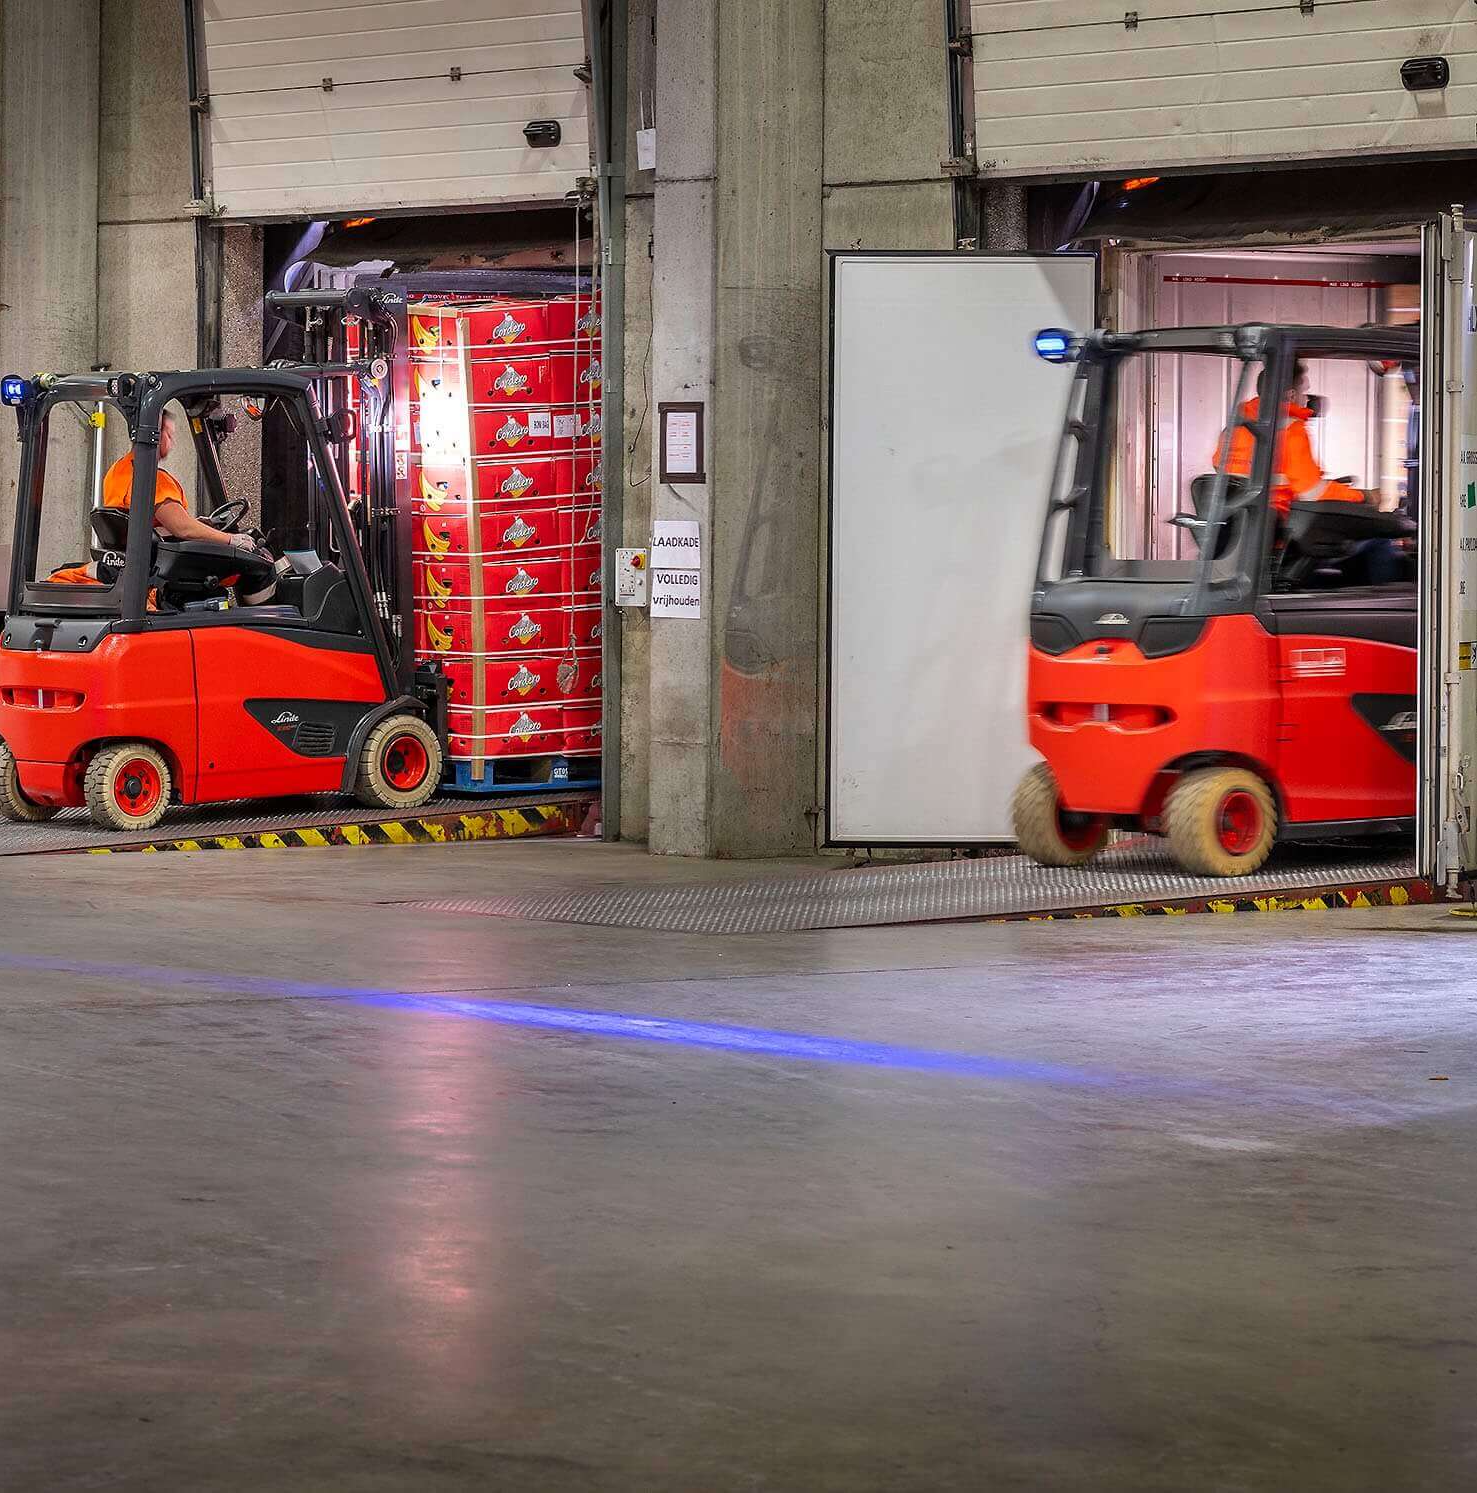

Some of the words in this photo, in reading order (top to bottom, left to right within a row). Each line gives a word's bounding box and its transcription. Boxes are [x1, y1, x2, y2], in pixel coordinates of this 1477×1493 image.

[493, 323, 525, 339] Cordero
[494, 374, 528, 391] Cordero
[496, 426, 528, 441] Cordero
[501, 477, 533, 492] Cordero
[503, 526, 535, 542] Cordero
[652, 537, 699, 547] LAADKADE
[657, 574, 698, 585] VOLLEDIG
[652, 594, 700, 607] vrijhouden
[509, 623, 541, 638] Cordero
[507, 674, 540, 690] Cordero
[270, 711, 299, 724] Linde
